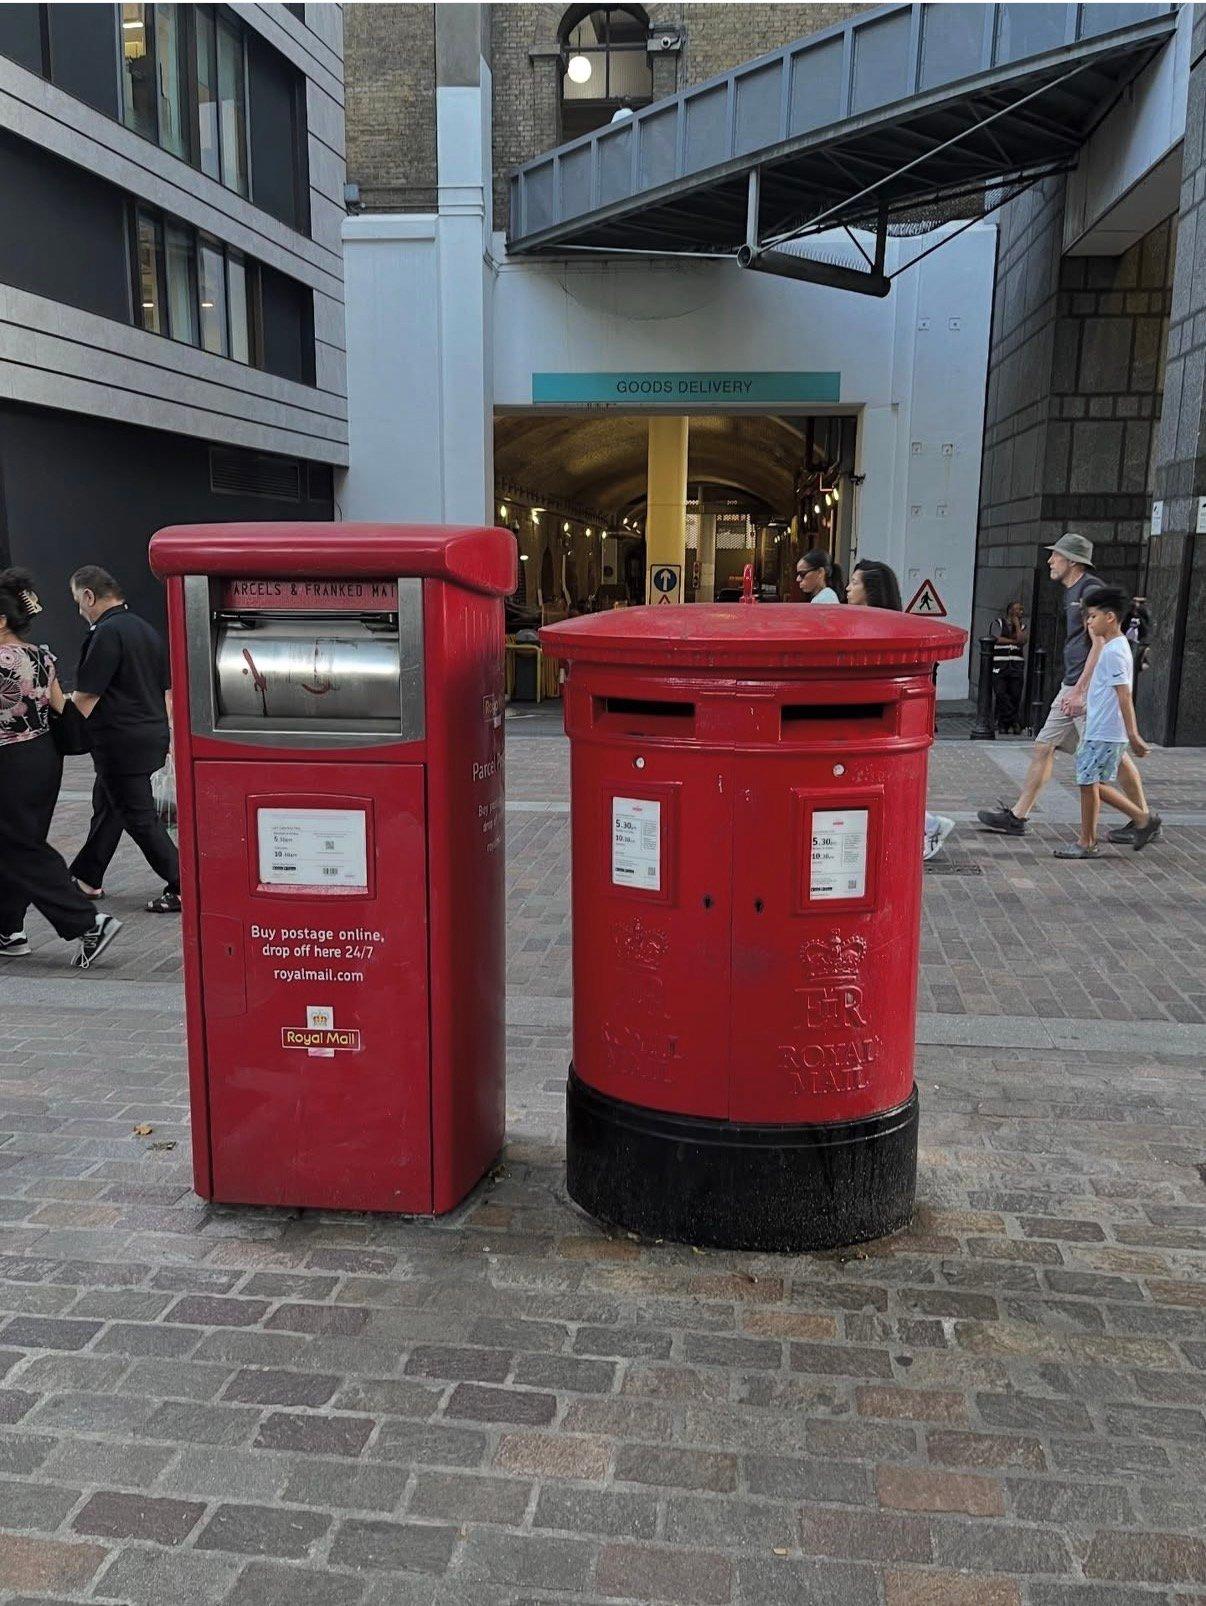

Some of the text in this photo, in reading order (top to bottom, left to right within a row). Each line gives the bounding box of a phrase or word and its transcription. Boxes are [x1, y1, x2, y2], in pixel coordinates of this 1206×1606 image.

[616, 380, 753, 394] GOODS DELIVERY
[232, 581, 395, 597] ARCELS & FRANKED MAI
[473, 755, 496, 782] Parcel
[251, 925, 385, 943] Buy postage online,
[262, 944, 374, 959] drop off here 24/7
[274, 968, 364, 982] royalmail.com
[287, 1031, 355, 1046] Royal Mail
[778, 1035, 882, 1068] ROYAL
